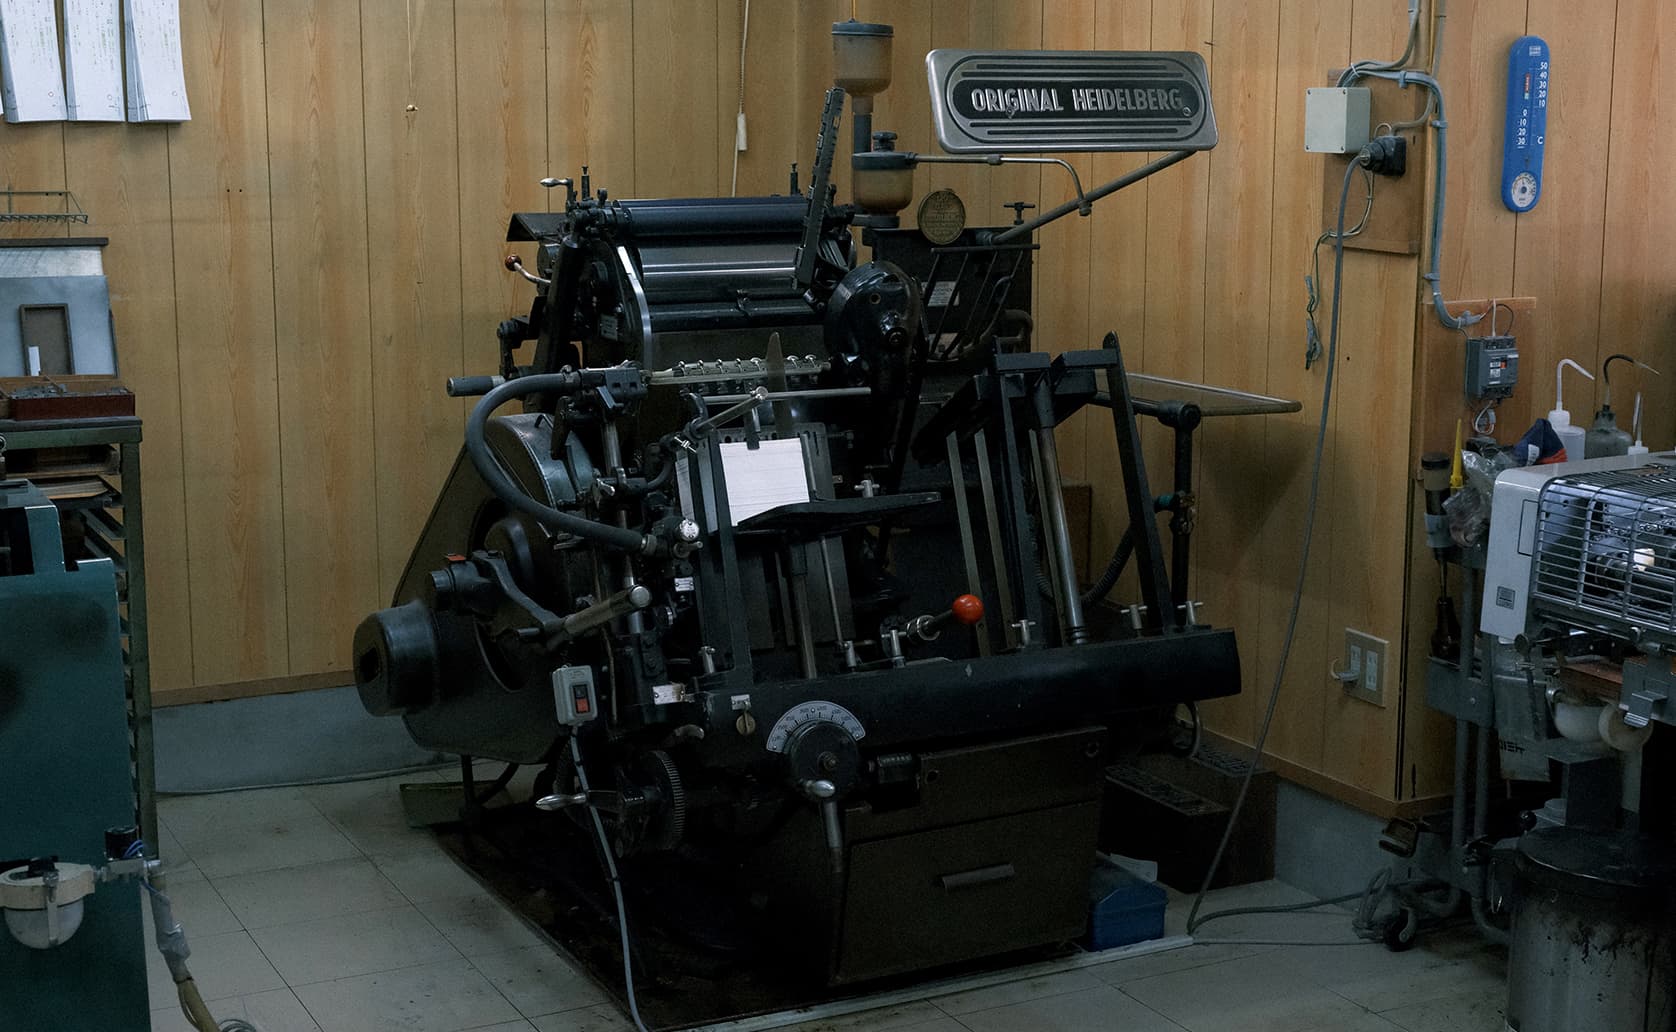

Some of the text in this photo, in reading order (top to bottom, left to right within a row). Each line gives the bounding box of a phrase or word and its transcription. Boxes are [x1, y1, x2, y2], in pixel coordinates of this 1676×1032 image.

[1541, 61, 1548, 70] 50
[1540, 71, 1547, 79] 40
[1539, 81, 1546, 89] 30
[1539, 90, 1546, 98] 20
[971, 87, 1184, 112] ORIGINAL HEIDELBERG
[1539, 99, 1545, 107] 10
[1523, 109, 1528, 117] 0
